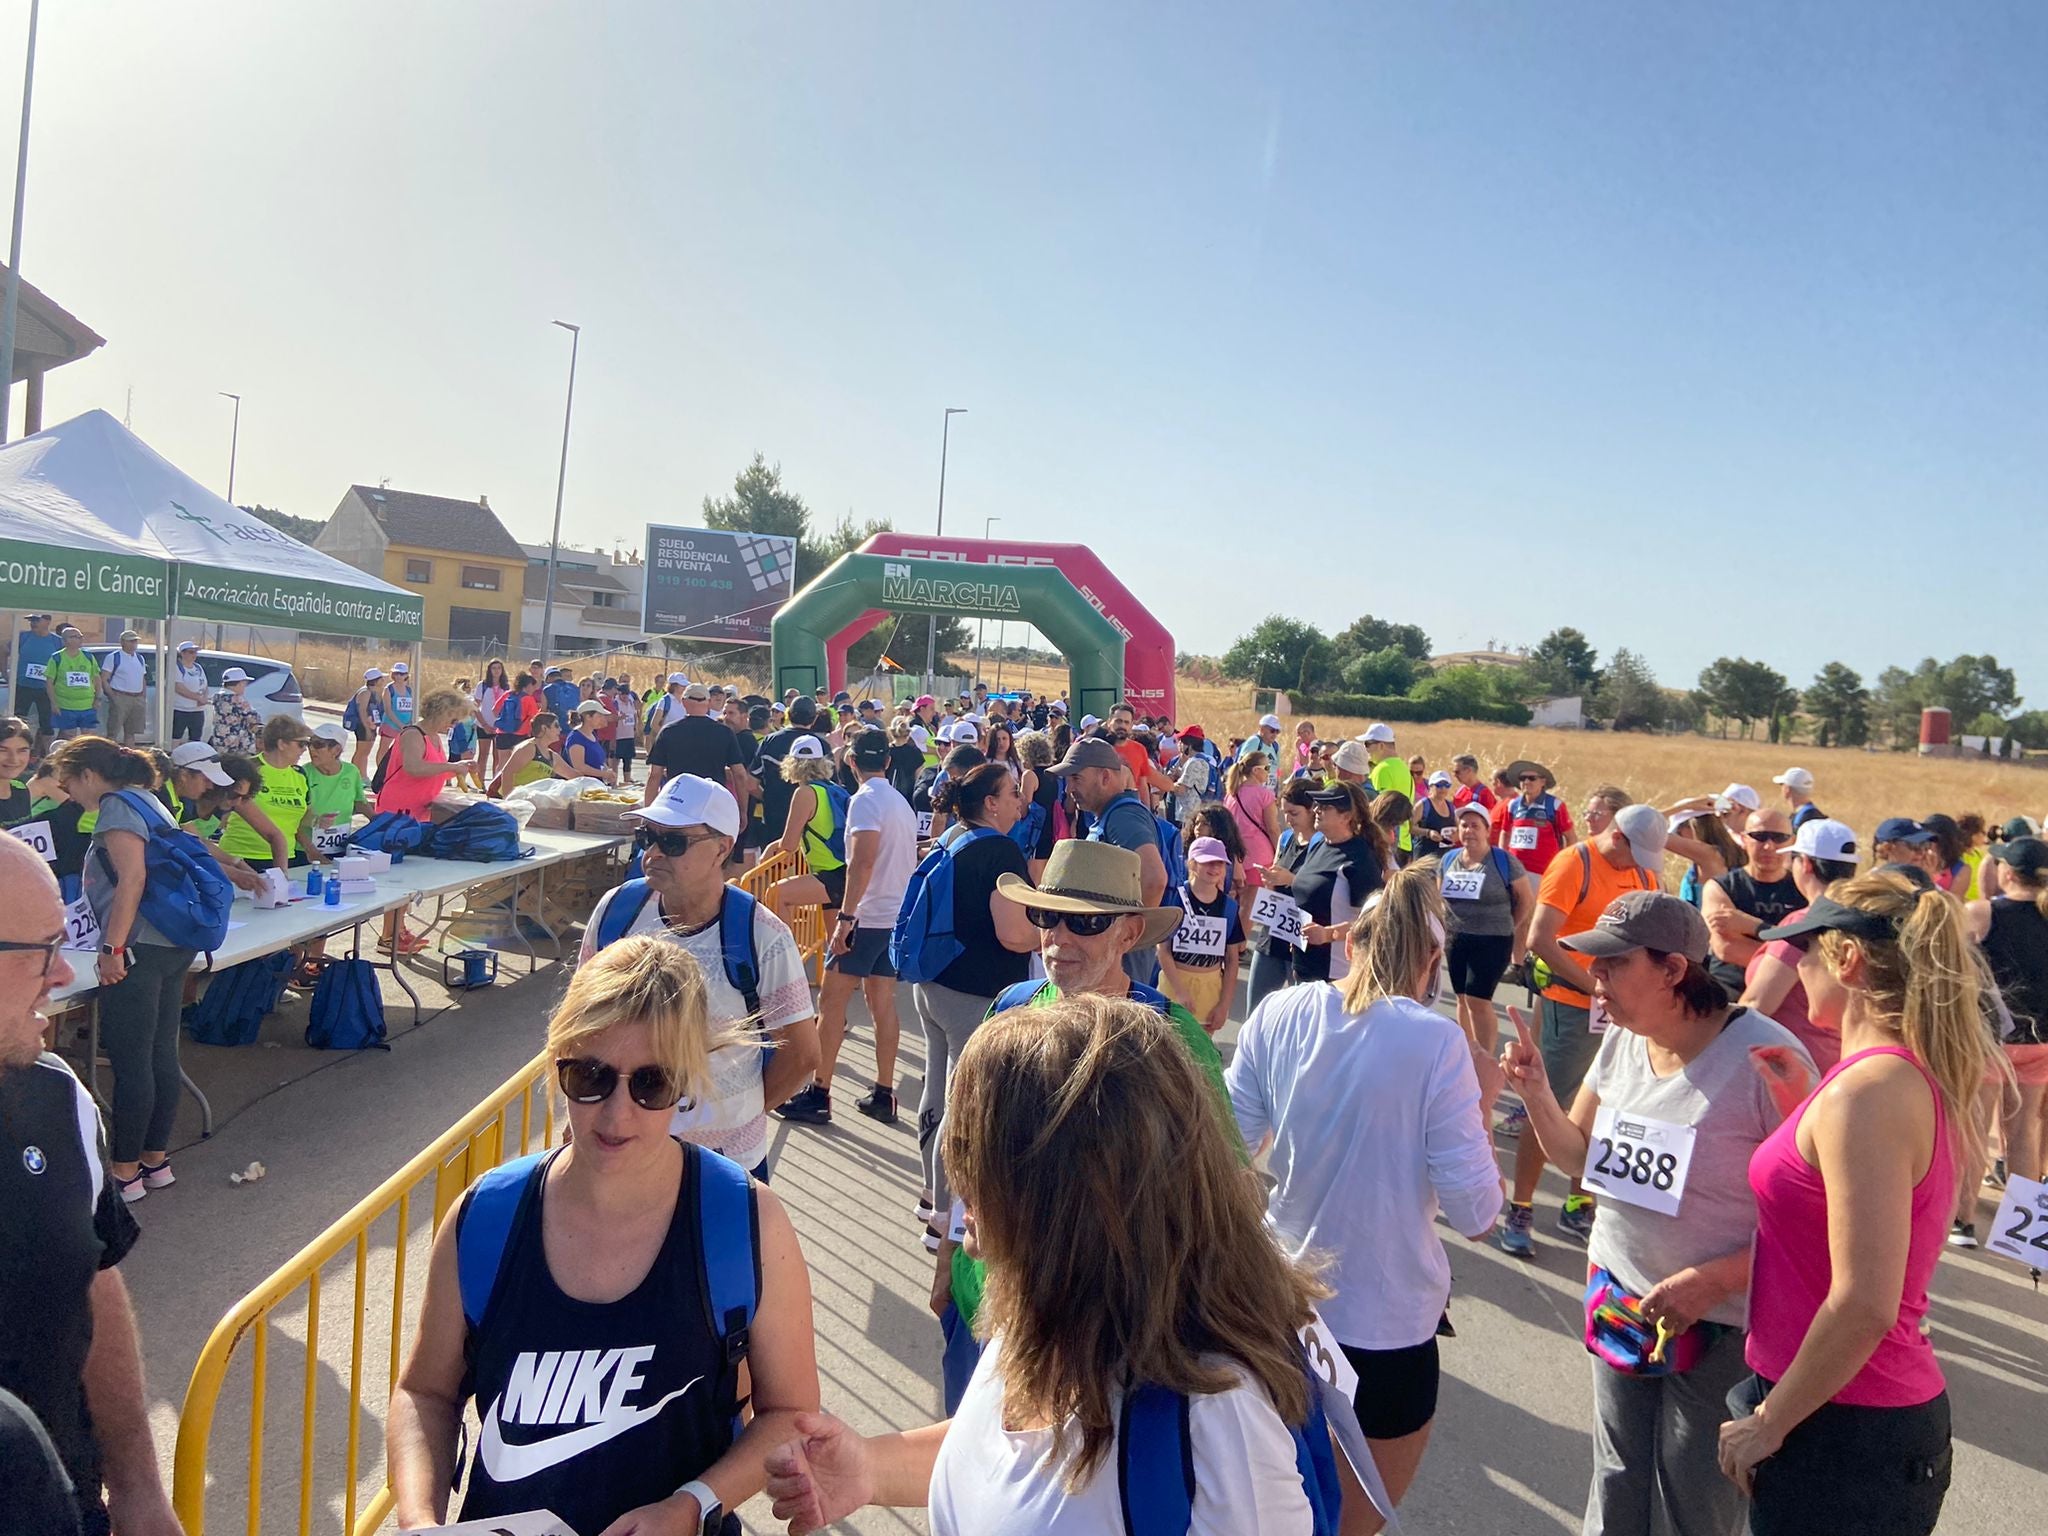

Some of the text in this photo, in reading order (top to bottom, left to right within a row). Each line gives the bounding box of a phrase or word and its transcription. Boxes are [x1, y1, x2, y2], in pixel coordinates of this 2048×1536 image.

[658, 538, 695, 549] SUELO
[658, 549, 731, 564] RESIDENCIAL
[657, 559, 713, 573] EN VENTA
[883, 562, 912, 578] EN
[0, 560, 162, 597] contra el Cáncer
[656, 574, 734, 591] 919 100 438
[882, 575, 1021, 609] MARCHA
[184, 578, 422, 626] Asociación Española contra el Cáncer
[1445, 879, 1478, 893] 2373
[1179, 927, 1222, 947] 2447
[1593, 1137, 1678, 1192] 2388
[501, 1344, 656, 1425] NIKE
